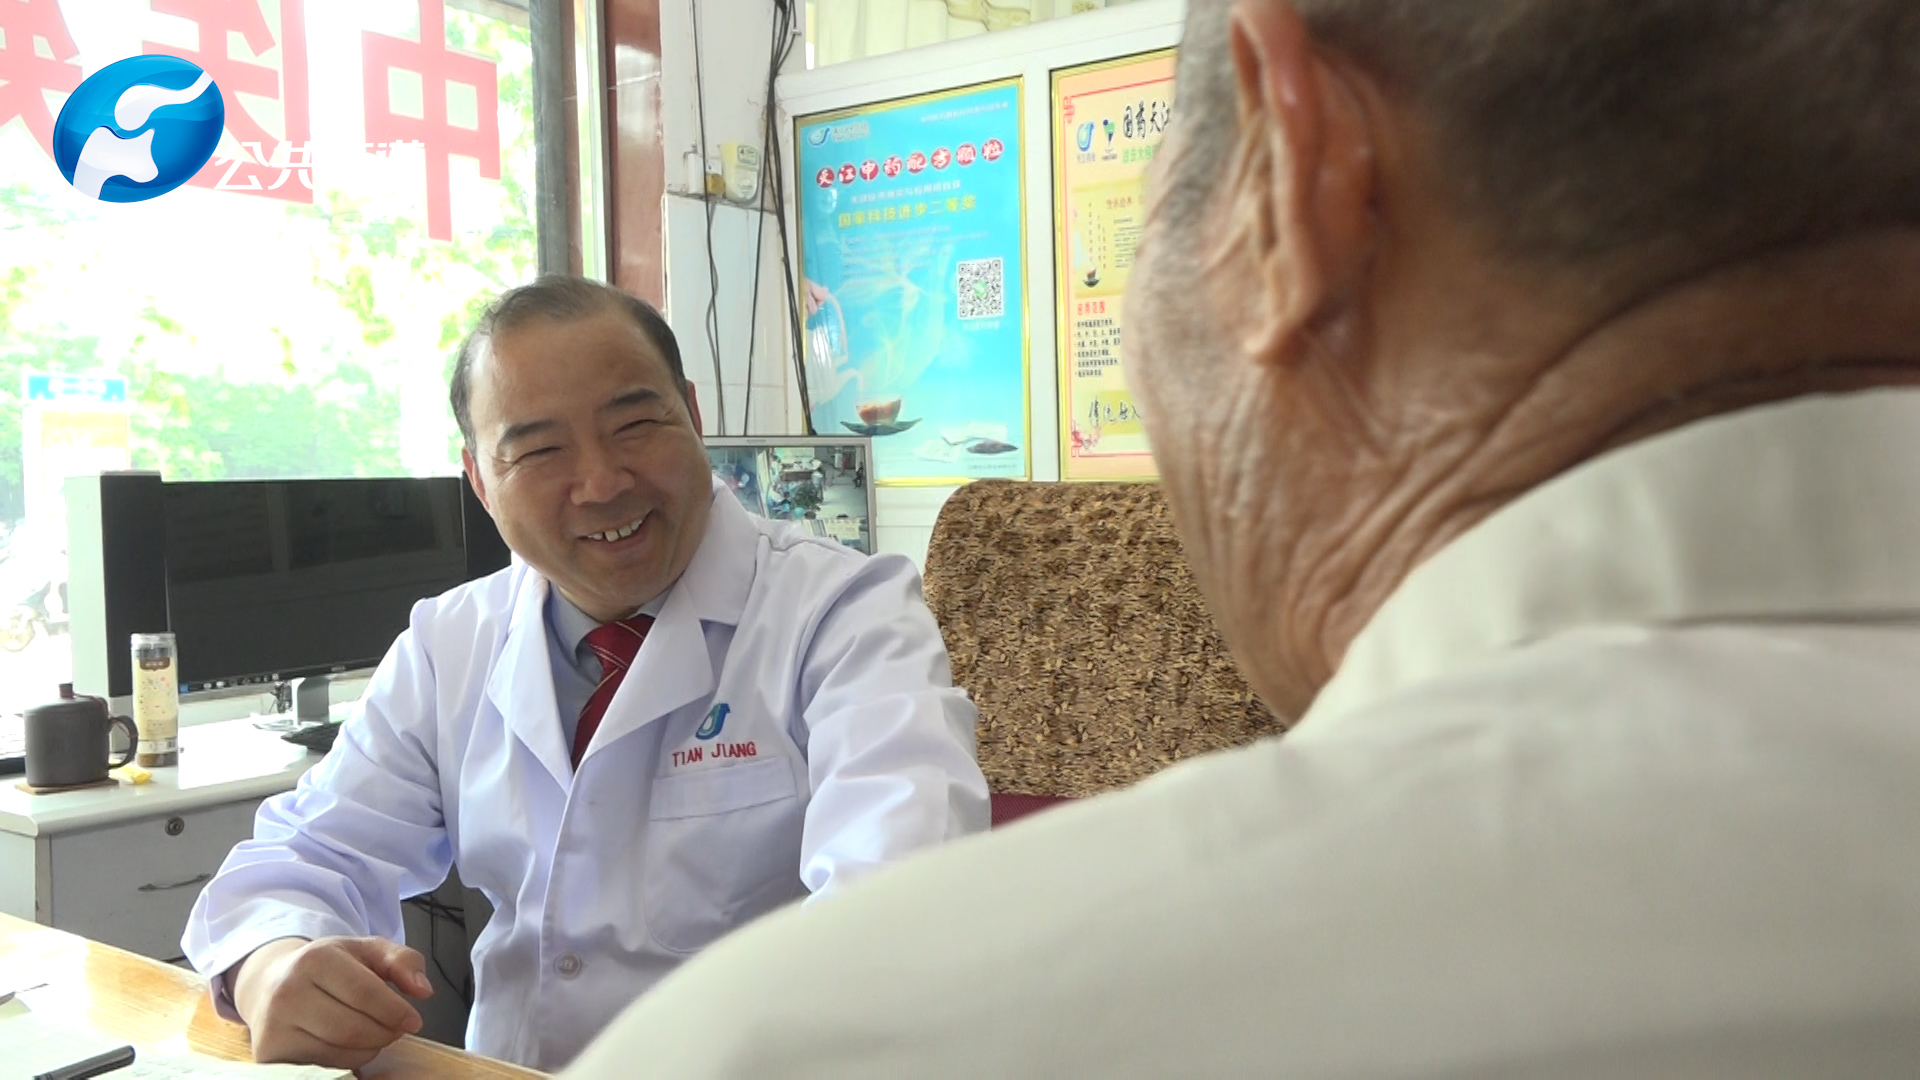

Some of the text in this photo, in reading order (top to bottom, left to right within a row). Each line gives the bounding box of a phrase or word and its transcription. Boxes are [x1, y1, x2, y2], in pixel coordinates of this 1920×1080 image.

[816, 139, 1004, 188] 天江中药配方颗粒
[672, 741, 757, 767] TIAN JIANG
